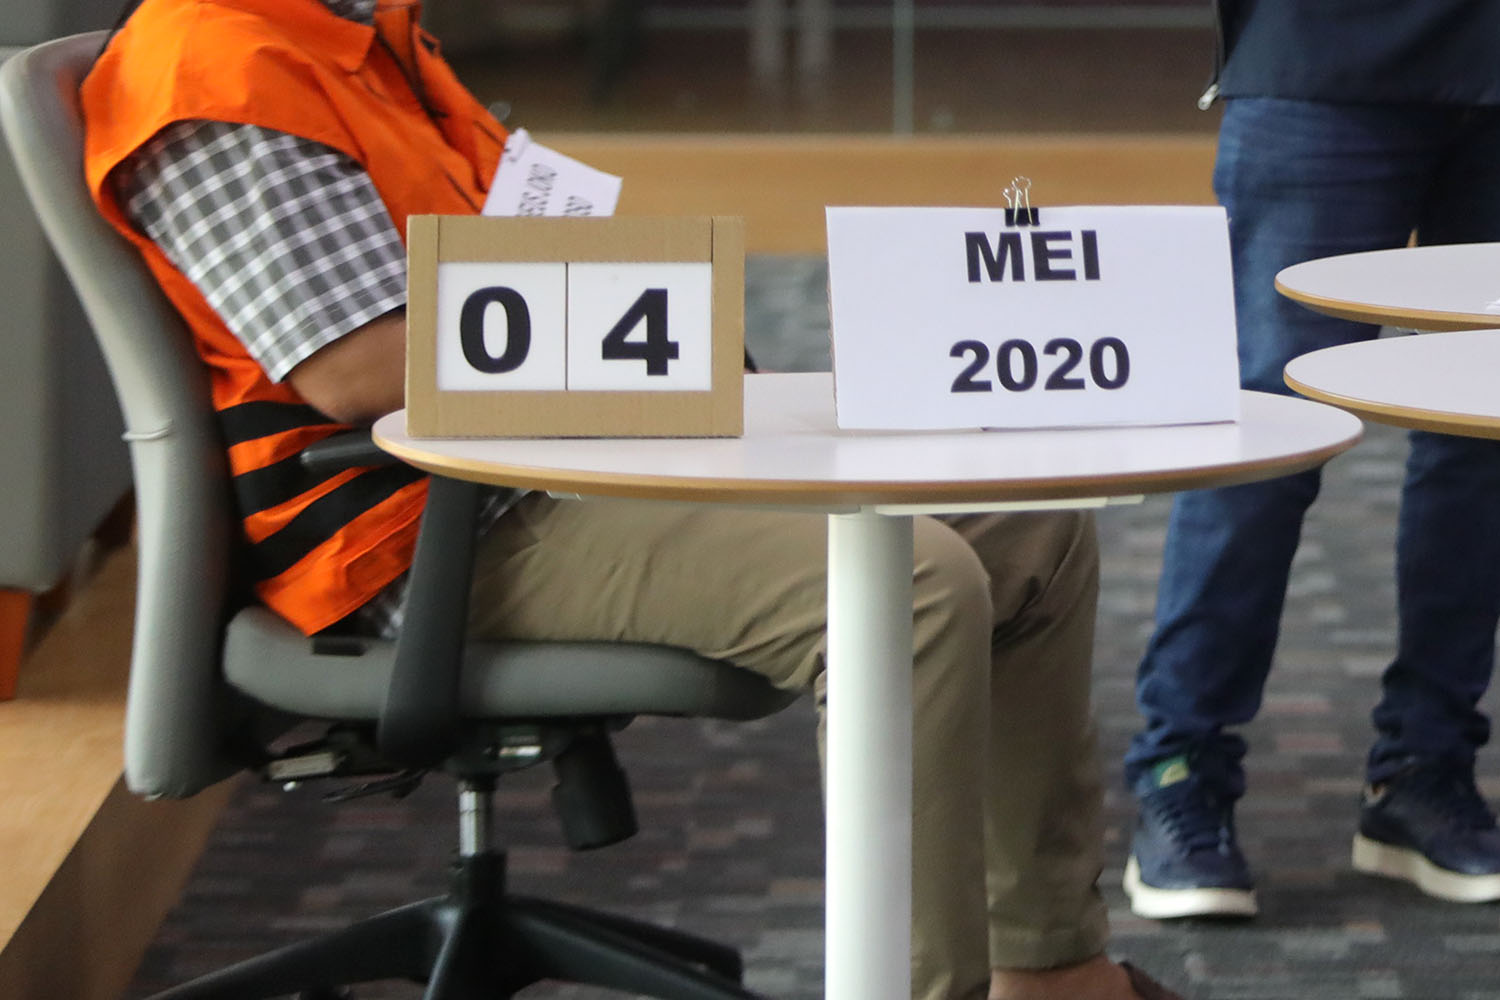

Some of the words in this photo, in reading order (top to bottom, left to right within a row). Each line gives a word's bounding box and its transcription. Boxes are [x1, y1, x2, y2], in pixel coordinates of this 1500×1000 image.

[964, 229, 1102, 284] MEI
[459, 286, 533, 375] 0
[601, 288, 681, 377] 4
[948, 336, 1132, 394] 2020
